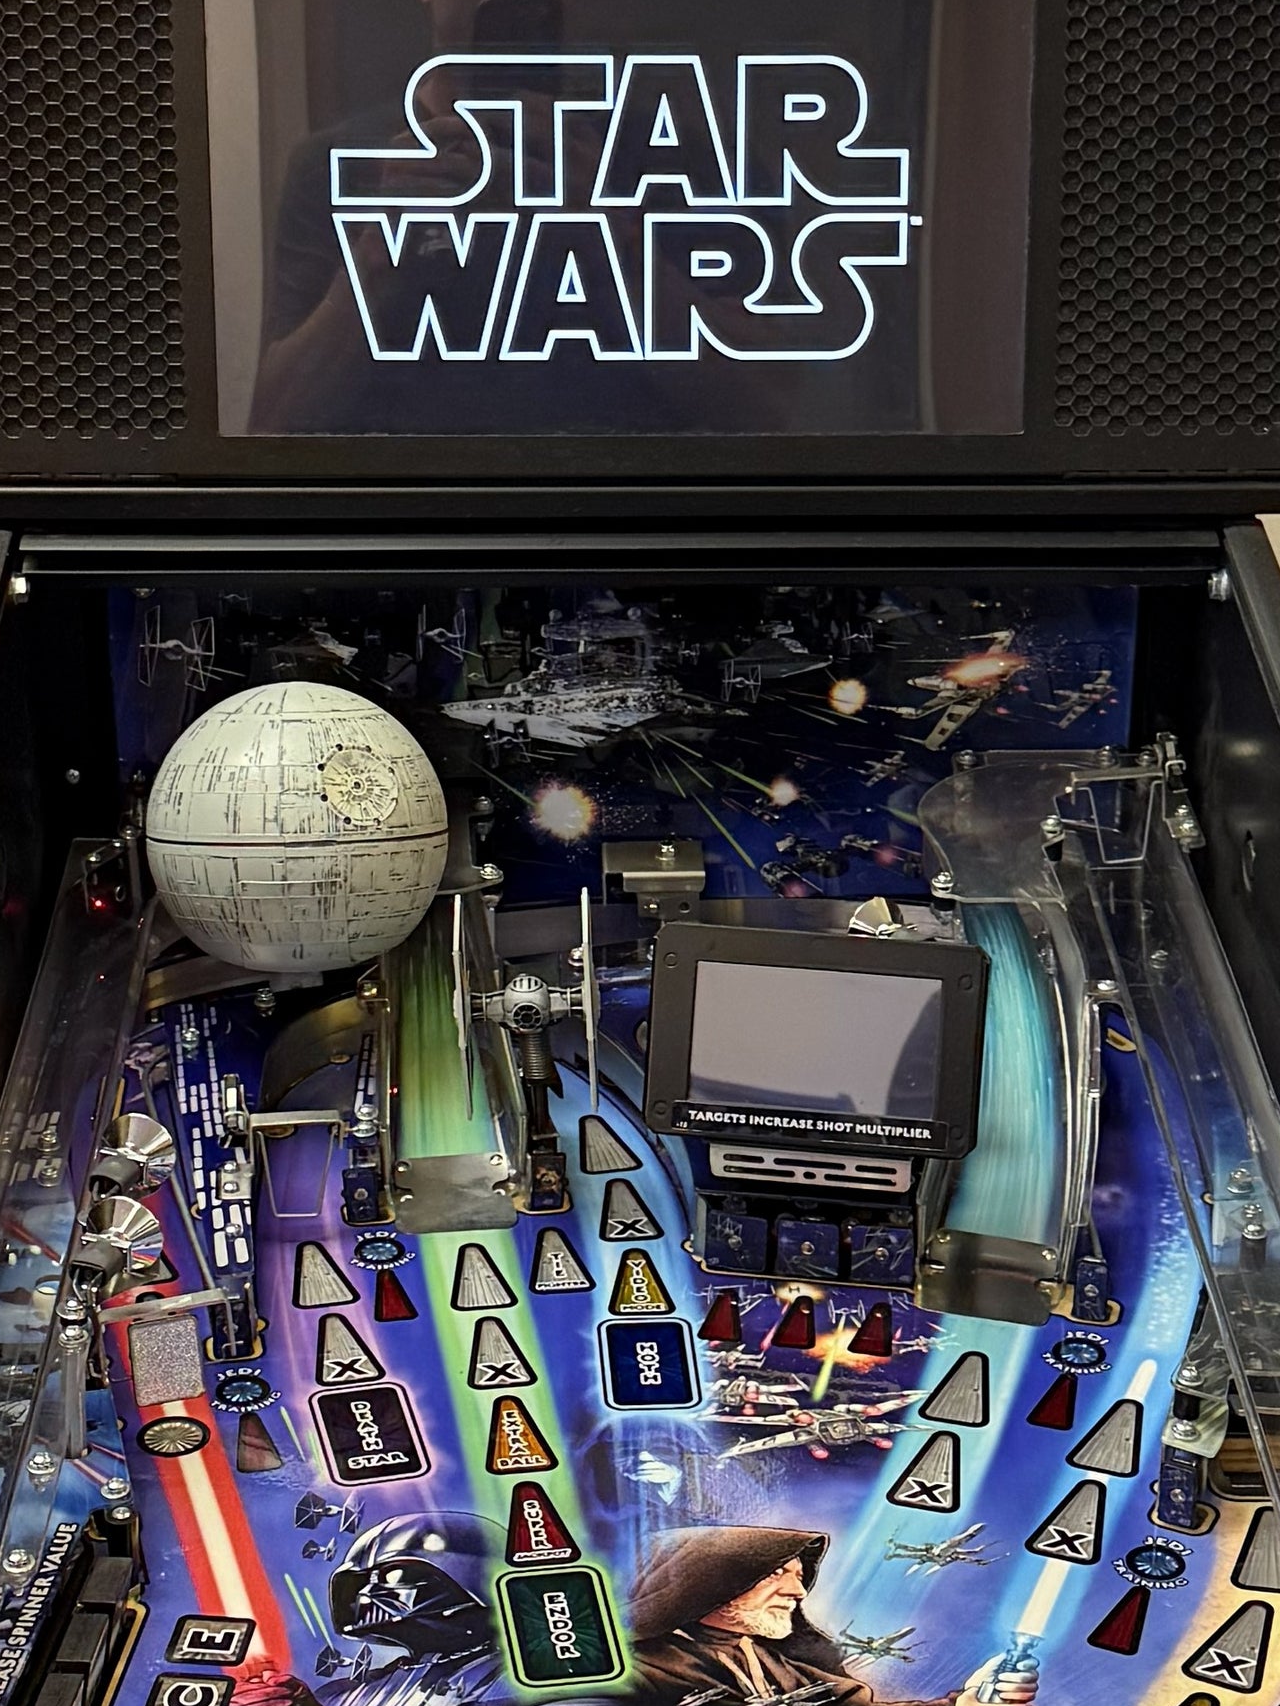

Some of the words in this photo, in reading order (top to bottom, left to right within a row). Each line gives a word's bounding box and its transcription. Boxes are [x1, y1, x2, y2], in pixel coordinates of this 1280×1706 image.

[330, 54, 909, 207] STAR
[331, 212, 909, 362] WARS
[688, 1110, 747, 1124] TARGETS
[749, 1114, 814, 1129] INCREASE
[816, 1120, 853, 1133] SHOT
[855, 1123, 932, 1140] MULTIPLIER
[356, 1231, 397, 1243] JEDI
[350, 1252, 416, 1271] TRAINING
[1065, 1331, 1110, 1345] JEDI
[217, 1368, 262, 1381] JEDI
[1041, 1351, 1112, 1375] TRAINING
[210, 1391, 282, 1413] TRAINING
[348, 1451, 410, 1470] STAR
[1143, 1535, 1194, 1557] JEDI
[10, 1573, 54, 1648] SPINNER
[43, 1522, 78, 1575] VALUE
[1112, 1558, 1189, 1589] TRAINING
[543, 1592, 581, 1659] ENDOR
